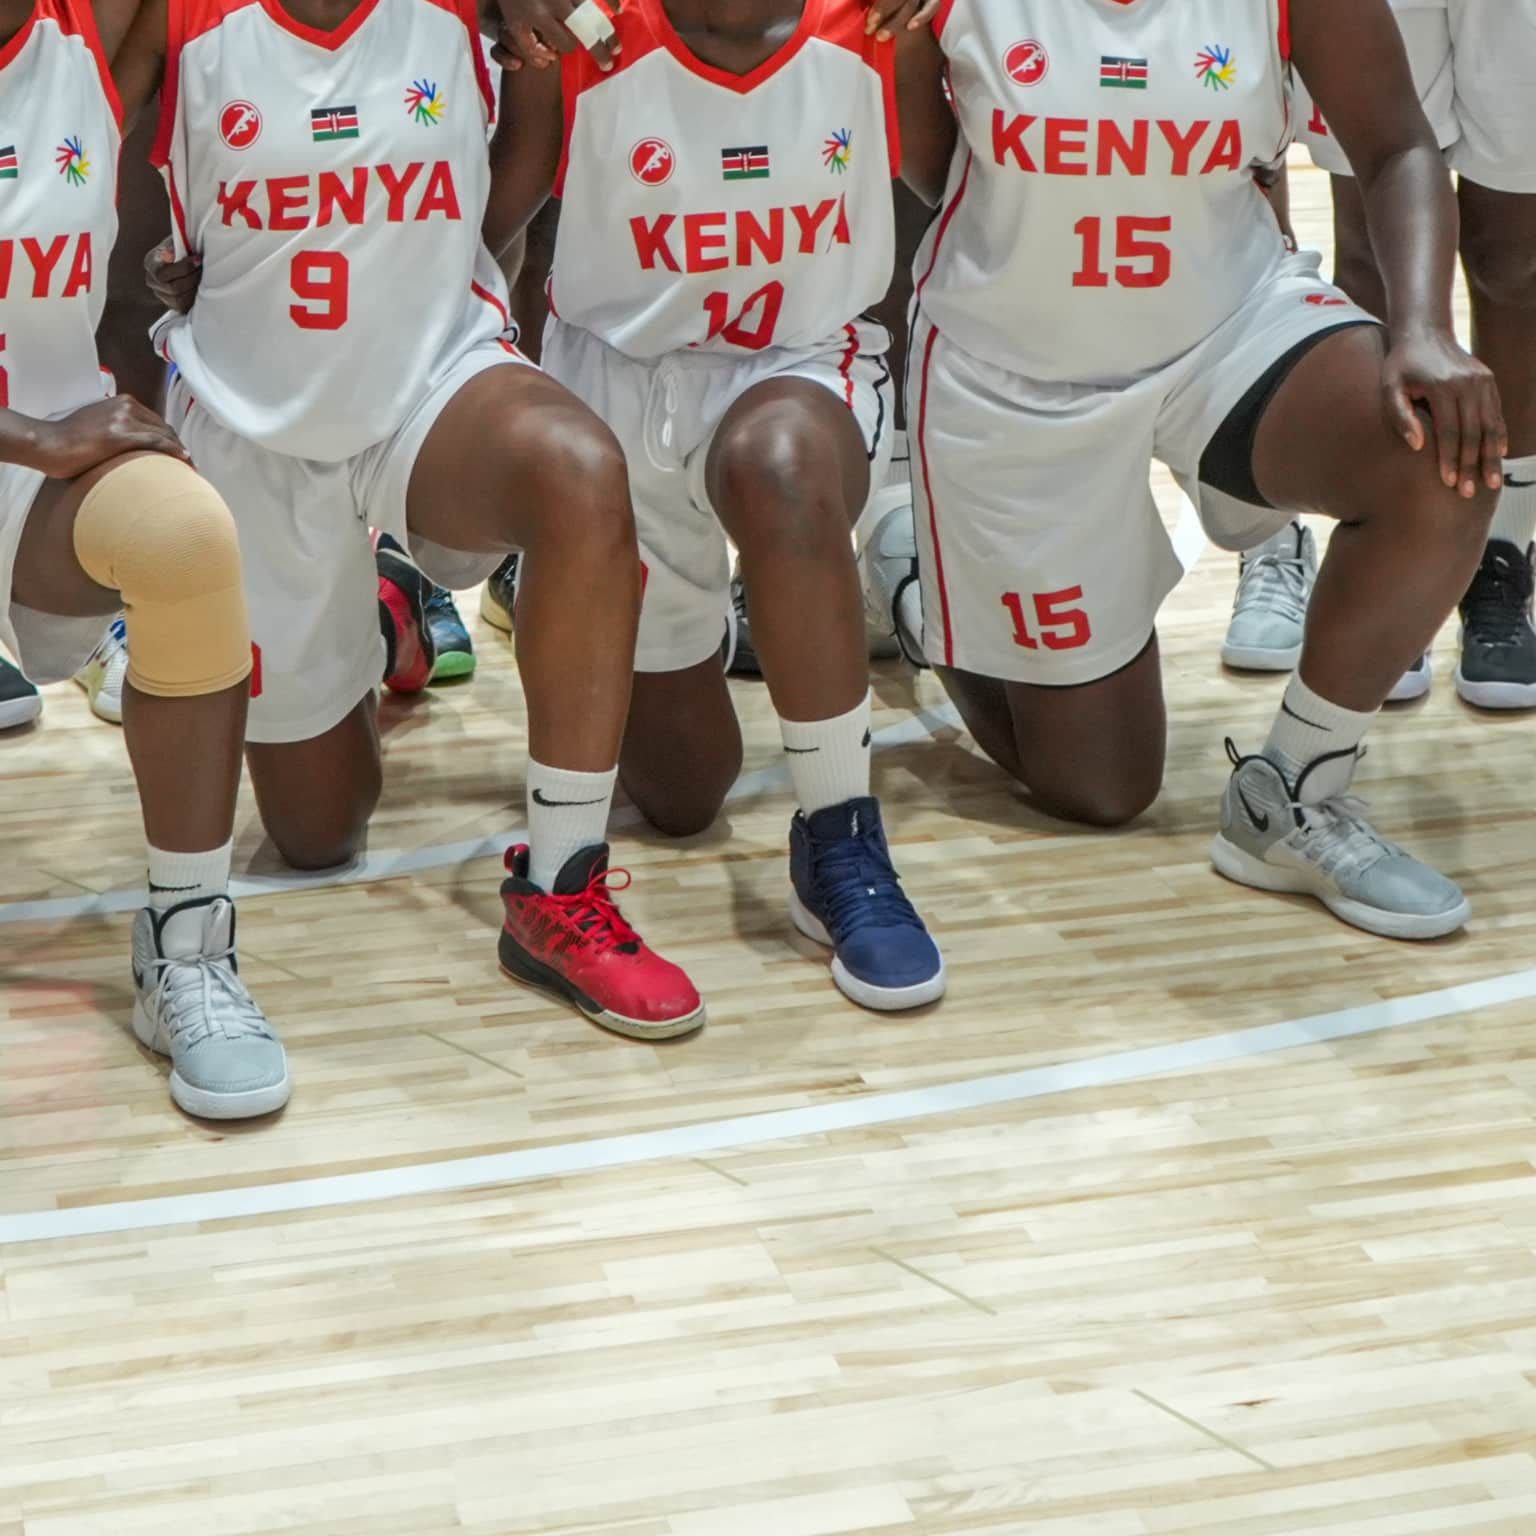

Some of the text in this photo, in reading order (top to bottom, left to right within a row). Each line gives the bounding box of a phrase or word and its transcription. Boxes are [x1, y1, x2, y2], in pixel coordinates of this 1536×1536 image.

[991, 107, 1243, 177] KENYA
[217, 160, 463, 232] KENYA
[629, 198, 852, 274] KENYA
[1072, 215, 1173, 289] 15
[288, 250, 351, 331] 9
[703, 279, 785, 351] 10
[1001, 585, 1092, 651] 15
